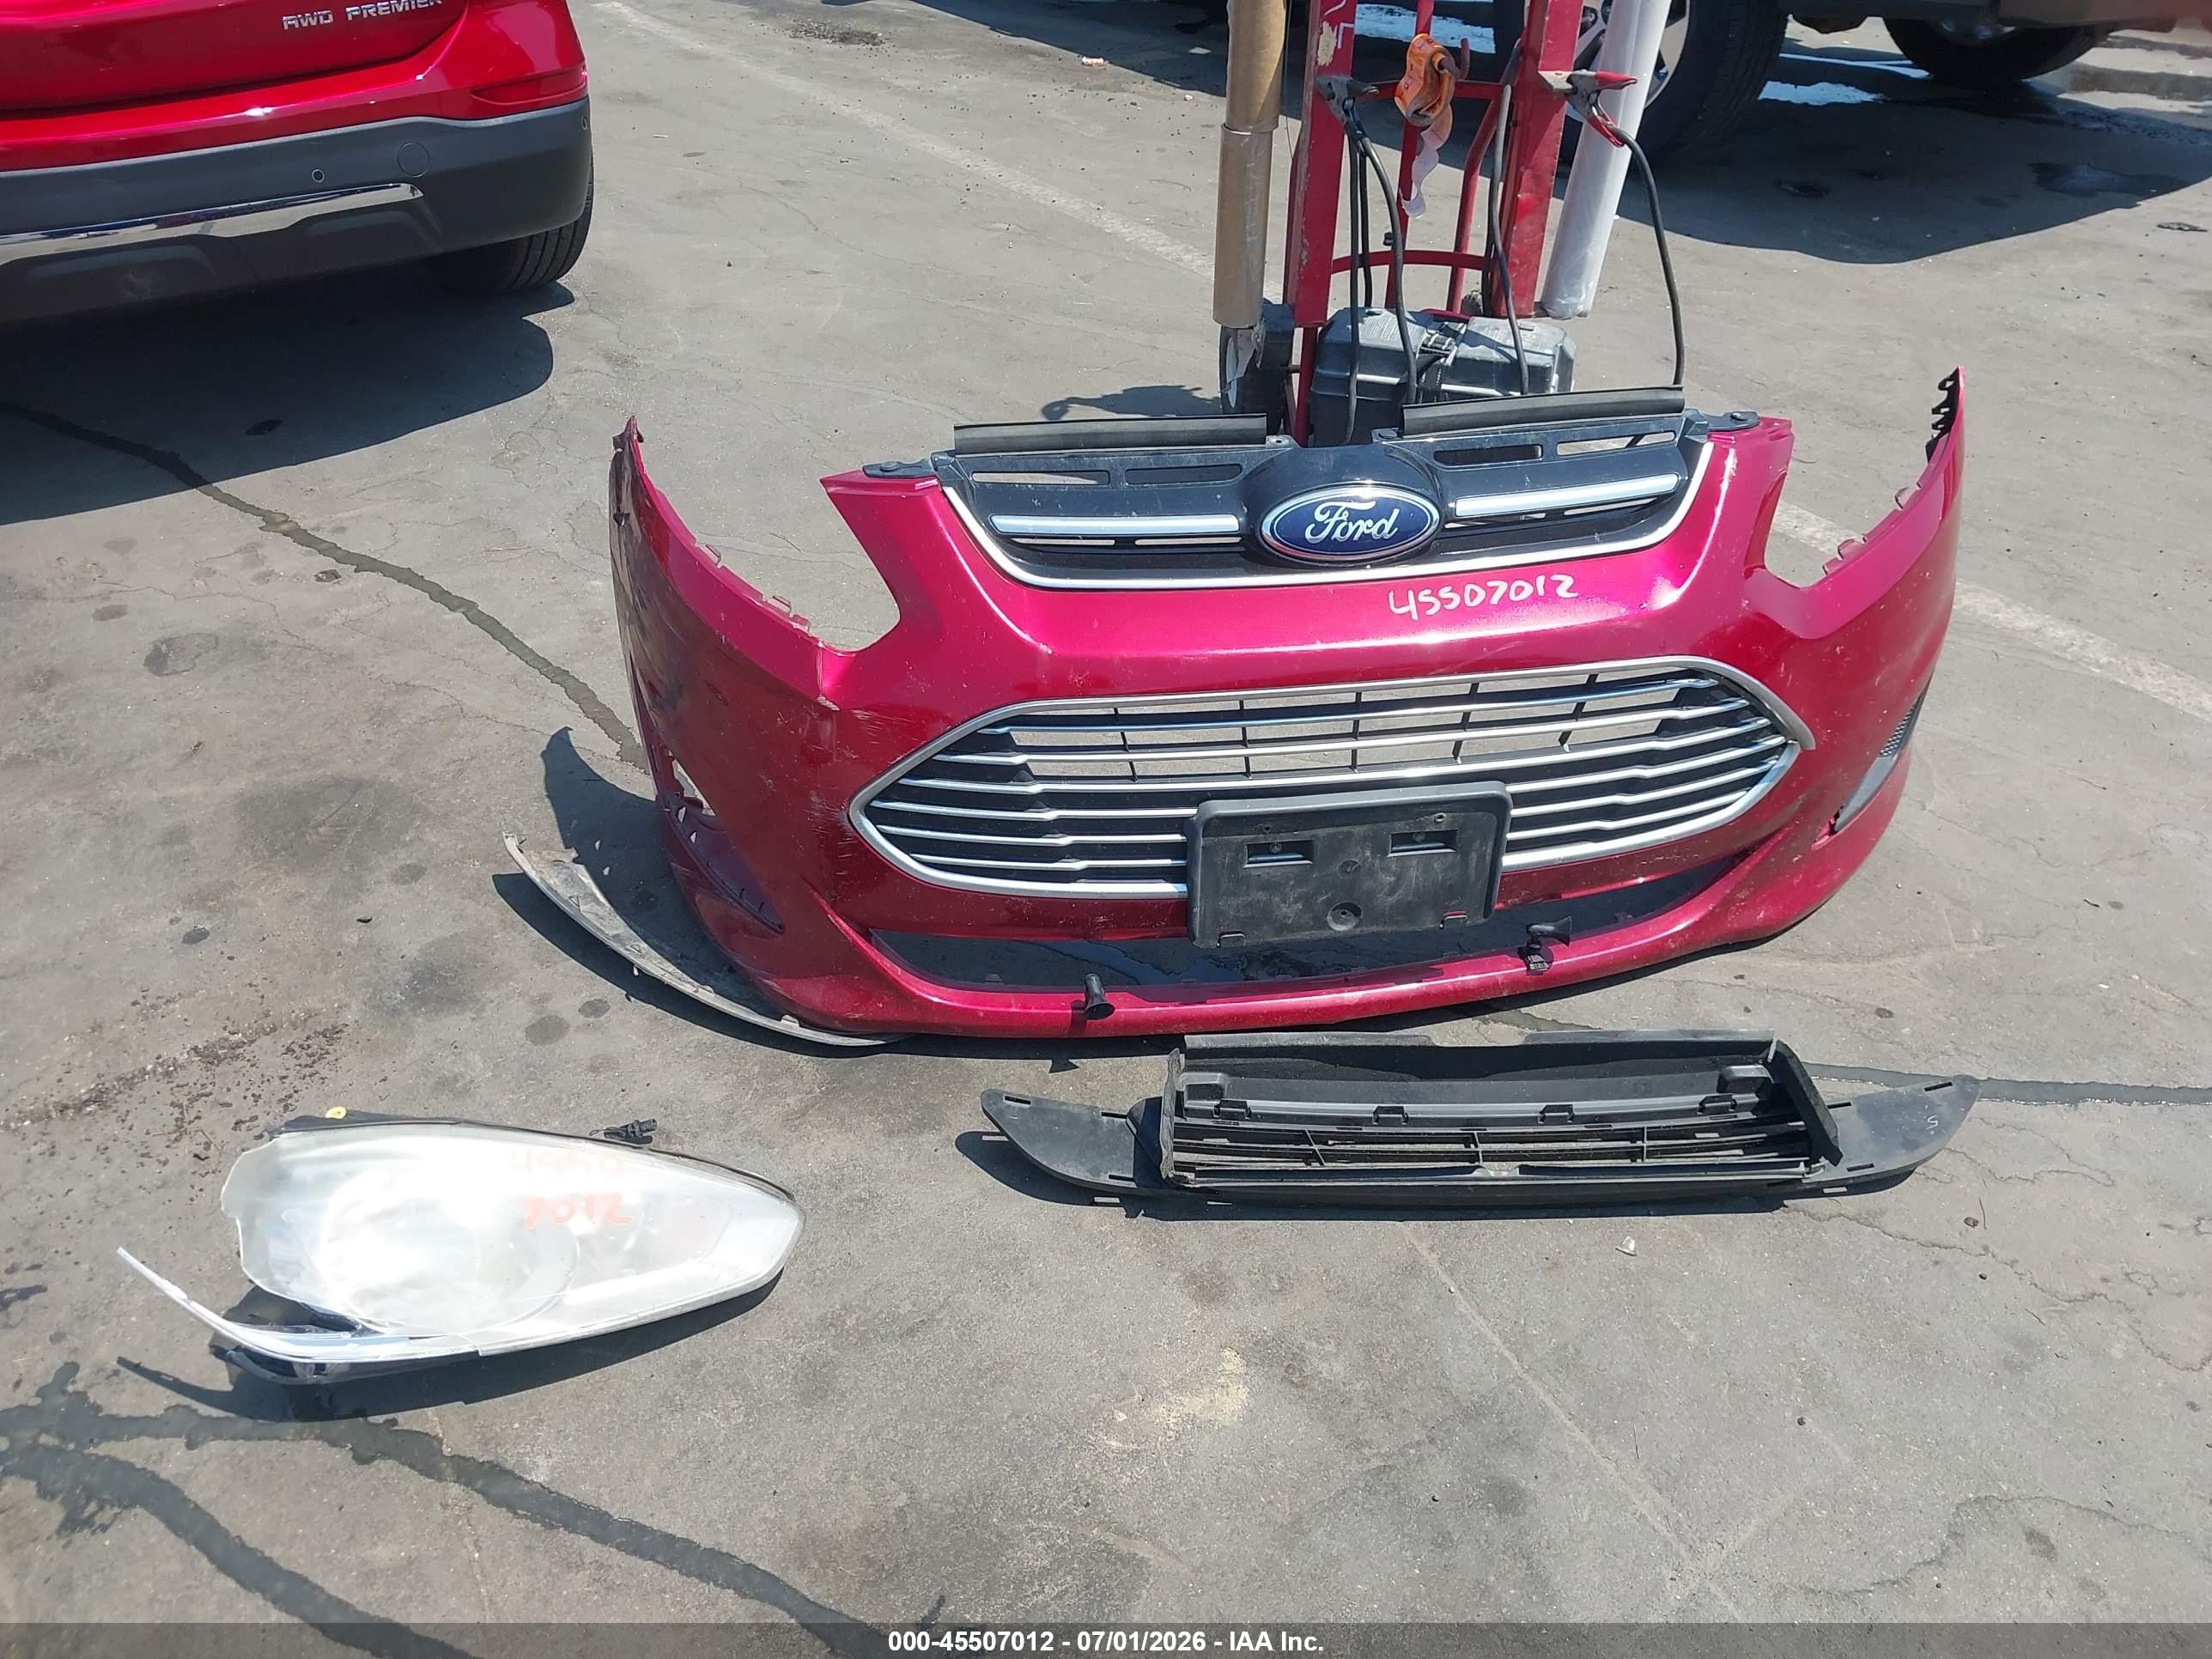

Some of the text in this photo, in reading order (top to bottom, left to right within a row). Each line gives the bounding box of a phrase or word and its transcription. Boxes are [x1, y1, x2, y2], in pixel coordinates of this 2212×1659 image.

[283, 10, 333, 30] AWD
[1305, 501, 1398, 544] Ford
[1389, 574, 1579, 620] 45507012
